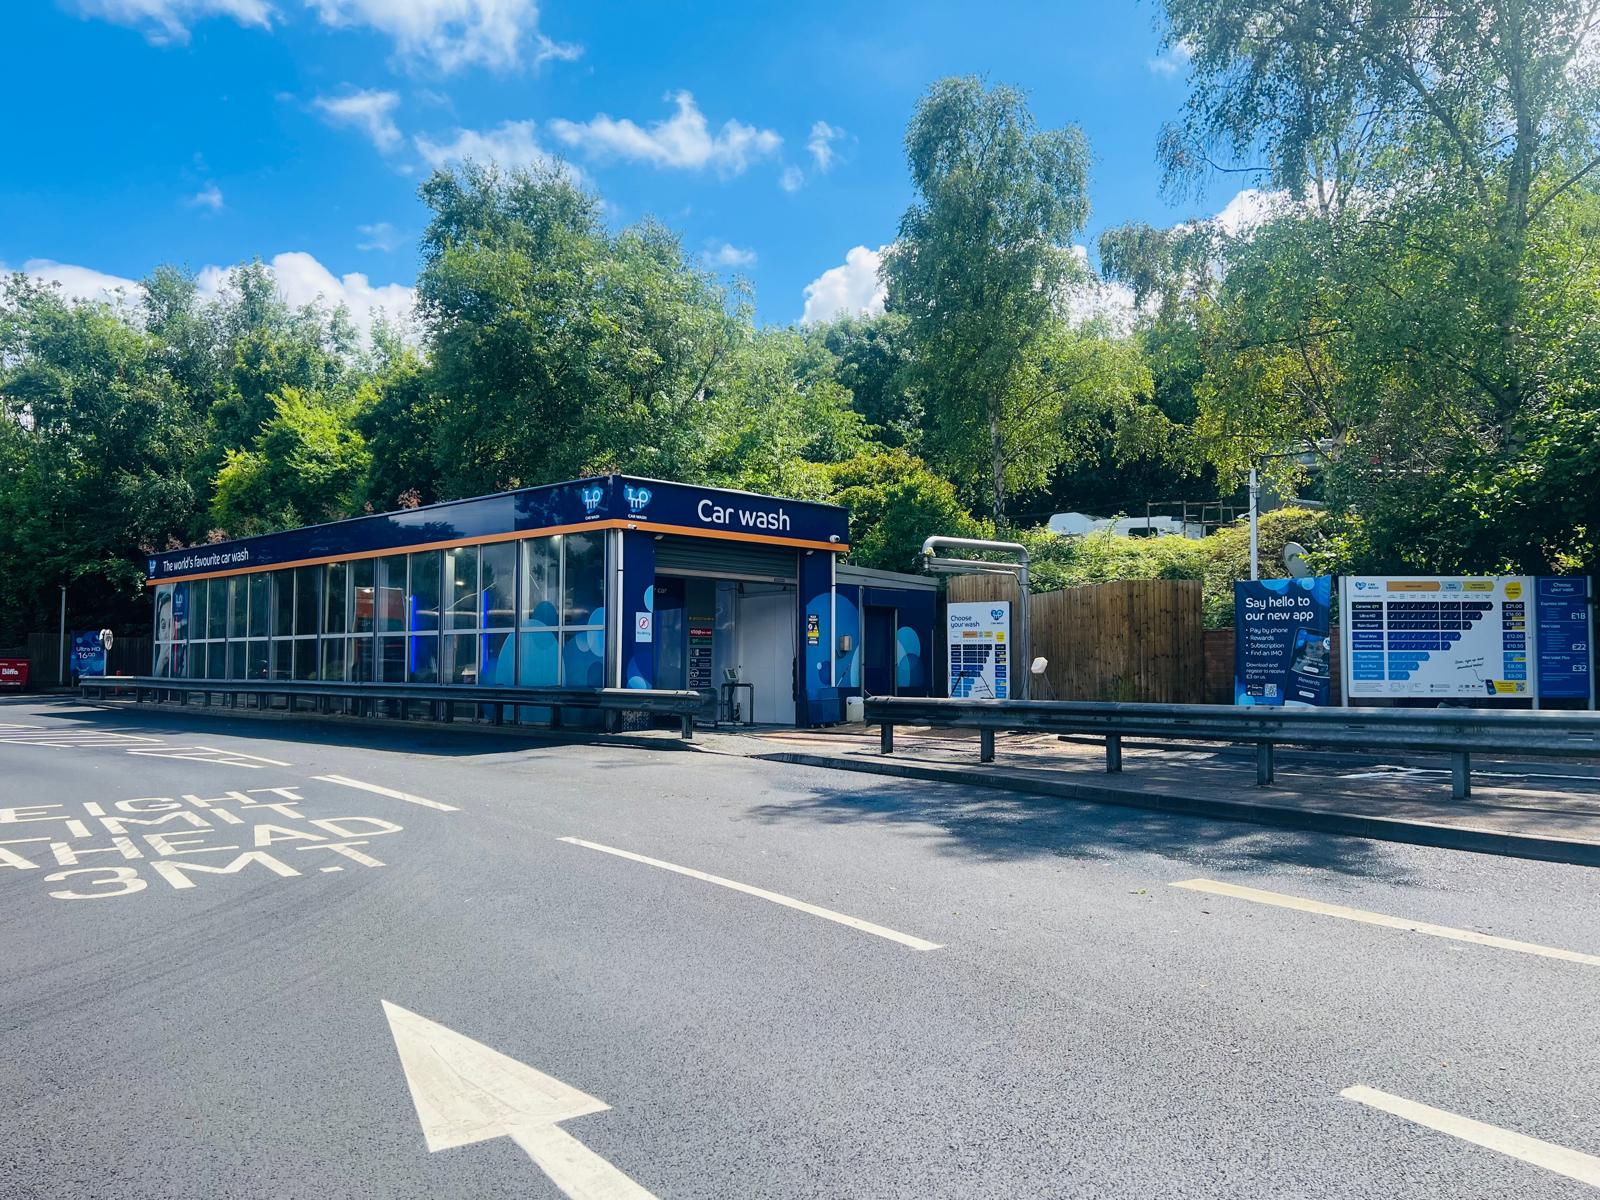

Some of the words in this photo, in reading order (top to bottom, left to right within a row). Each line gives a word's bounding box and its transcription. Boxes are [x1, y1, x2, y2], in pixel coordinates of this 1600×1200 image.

[697, 499, 734, 524] Car
[739, 508, 790, 531] wash
[163, 560, 173, 572] The
[174, 556, 193, 570] world's
[194, 553, 220, 567] favourite
[221, 553, 231, 564] car
[232, 548, 249, 562] wash
[1246, 597, 1266, 610] Say
[1269, 596, 1295, 607] hello
[1298, 596, 1310, 606] to
[1293, 611, 1314, 622] app
